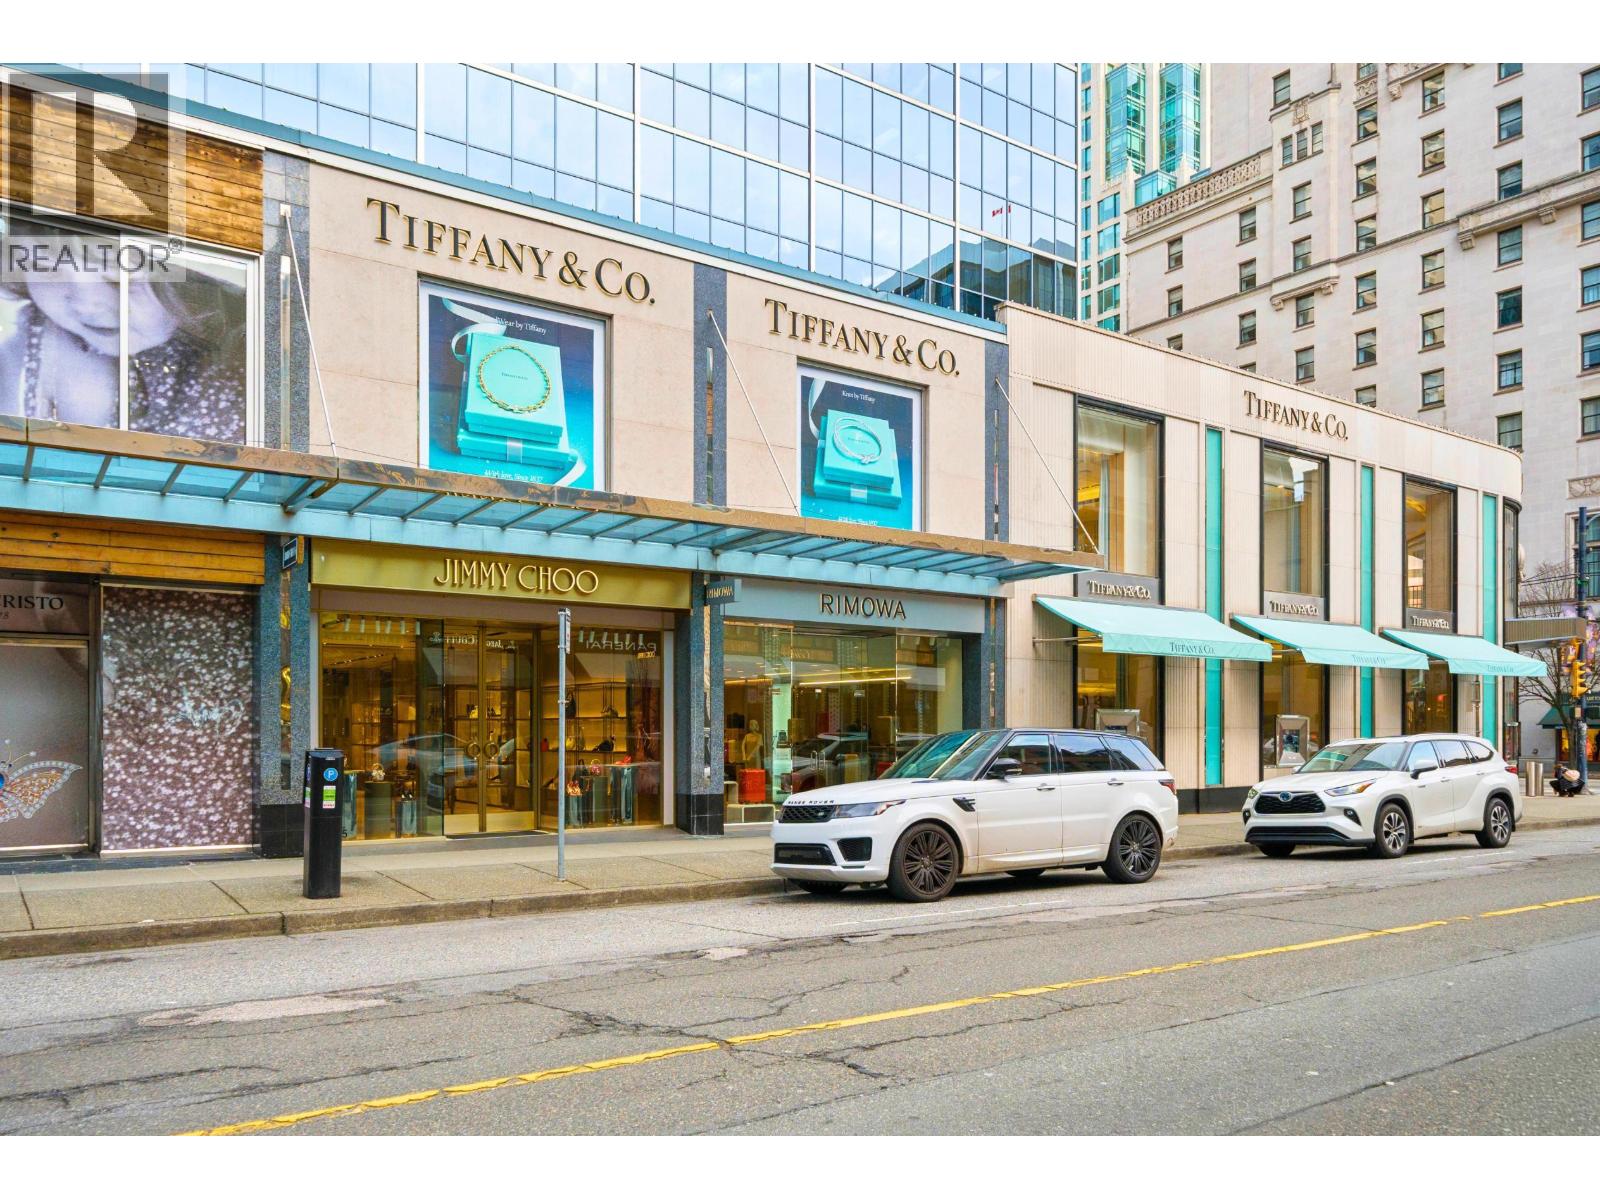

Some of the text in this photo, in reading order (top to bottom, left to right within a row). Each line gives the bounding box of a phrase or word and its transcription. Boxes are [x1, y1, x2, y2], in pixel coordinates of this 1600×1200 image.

[434, 558, 599, 595] JIMMY CHOO
[0, 594, 64, 610] RISTO
[819, 592, 907, 620] RIMOWA
